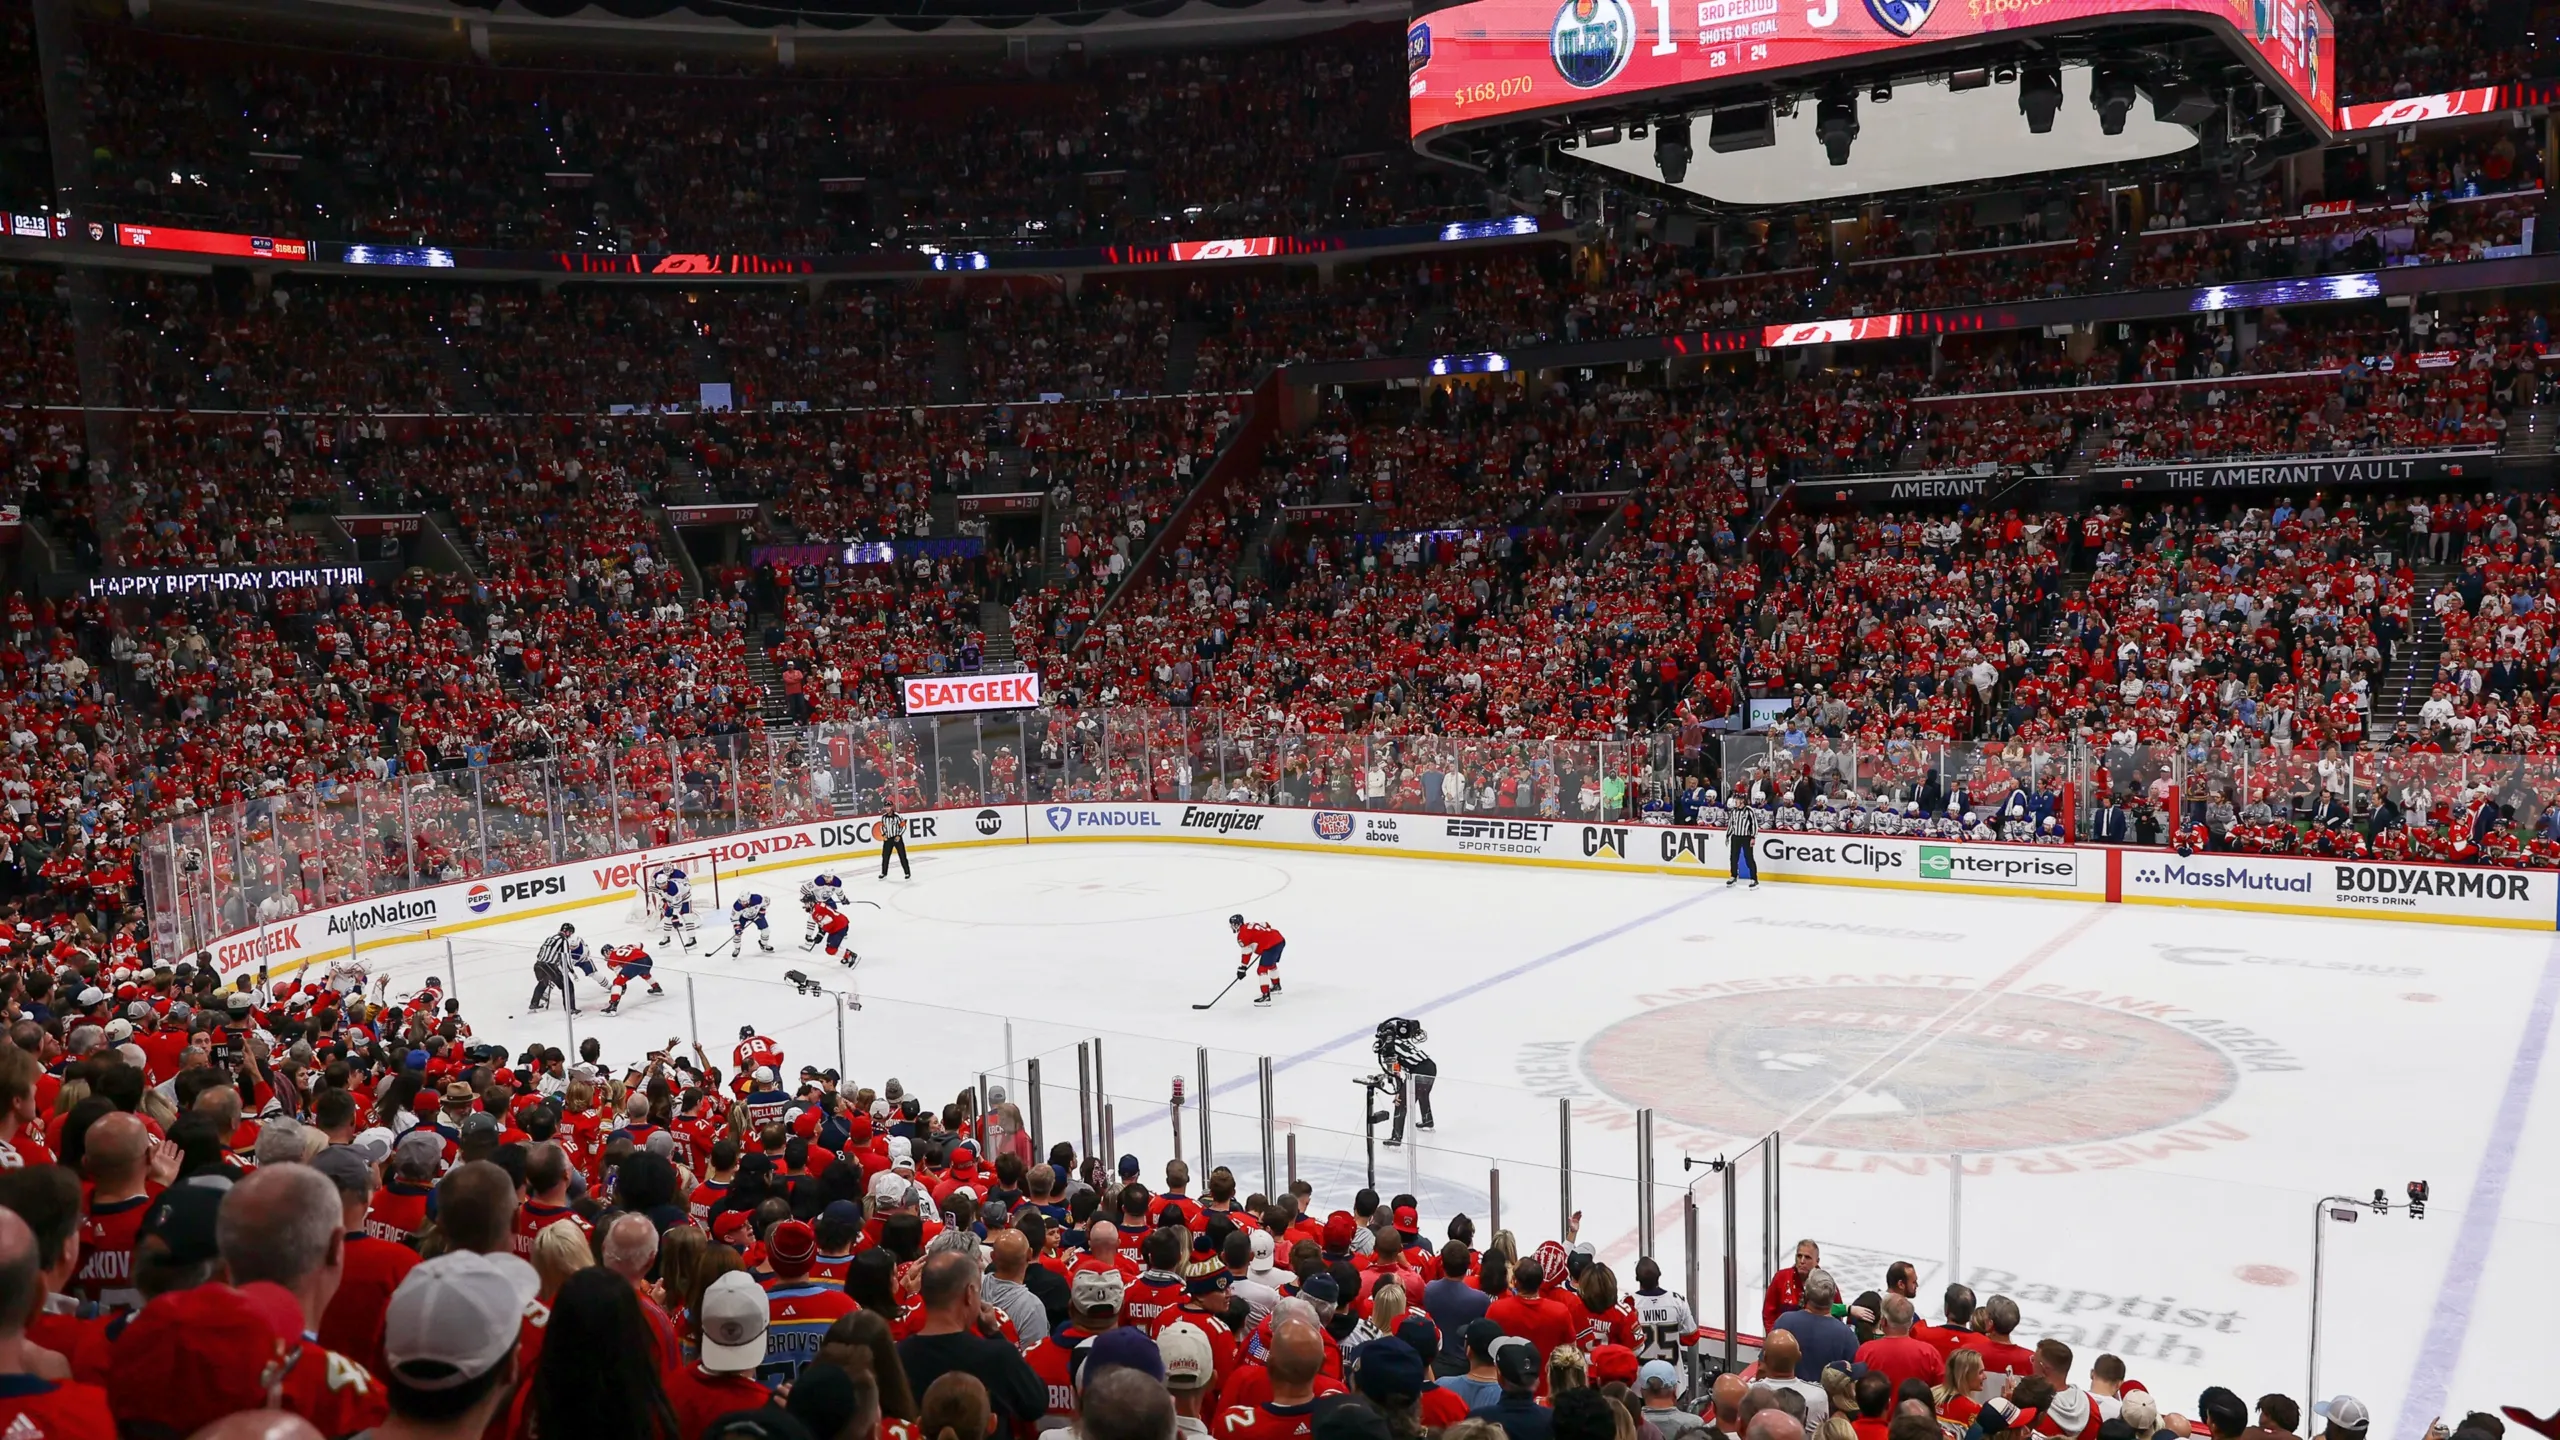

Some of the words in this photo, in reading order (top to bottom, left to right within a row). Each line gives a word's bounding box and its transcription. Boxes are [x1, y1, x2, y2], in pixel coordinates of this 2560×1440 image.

[1702, 6, 1725, 21] 3RD
[1700, 28, 1734, 45] SHOTS
[1735, 24, 1749, 39] ON
[1751, 19, 1778, 37] GOAL
[1710, 51, 1727, 68] 28
[1751, 44, 1767, 61] 24
[1455, 76, 1533, 108] $168,070
[15, 215, 46, 230] 02:13
[56, 221, 66, 237] 5
[133, 234, 145, 245] 24
[275, 244, 306, 255] $168,070
[2167, 471, 2204, 488] THE
[2211, 466, 2325, 486] AMERANT
[2332, 462, 2415, 482] VAULT
[1891, 479, 1986, 499] AMERANT
[672, 512, 689, 522] 128
[736, 509, 754, 520] 129
[401, 520, 418, 531] 128
[2086, 524, 2099, 537] 72
[90, 575, 161, 597] HAPPY
[268, 570, 319, 589] JOHN
[908, 676, 1038, 709] SEATGEEK
[976, 817, 1001, 829] TNT
[1077, 810, 1161, 827] FANDUEL
[1180, 806, 1264, 833] Energizer
[1317, 812, 1350, 829] Jersey
[1367, 820, 1375, 829] a
[1377, 818, 1397, 830] sub
[1366, 830, 1399, 843] above
[1446, 818, 1505, 840] ESPN
[1507, 822, 1553, 842] BET
[709, 832, 816, 863] HONDA
[1459, 841, 1542, 854] SPORTSBOOK
[1582, 826, 1629, 859] CAT
[1661, 830, 1709, 864] CAT
[1763, 838, 1836, 865] Great
[1842, 841, 1902, 872] Clips
[1929, 854, 2074, 877] enterprise
[2164, 864, 2312, 893] MassMutual
[2335, 865, 2530, 901] BODYARMOR
[468, 894, 492, 904] PEPSI
[501, 877, 566, 903] PEPSI
[2336, 894, 2379, 905] SPORTS
[2382, 897, 2417, 907] DRINK
[327, 898, 436, 936] AutoNation
[219, 924, 302, 974] SEATGEEK
[1634, 973, 1975, 1006] AMERANT
[2022, 983, 2195, 1020] BANK
[2172, 1017, 2306, 1074] ARENA
[739, 1039, 767, 1058] 88
[562, 1140, 579, 1154] 16
[1966, 1266, 2247, 1335] Baptist
[1643, 1309, 1668, 1322] WIND
[768, 1332, 826, 1352] BROVS
[2012, 1315, 2205, 1367] ealth
